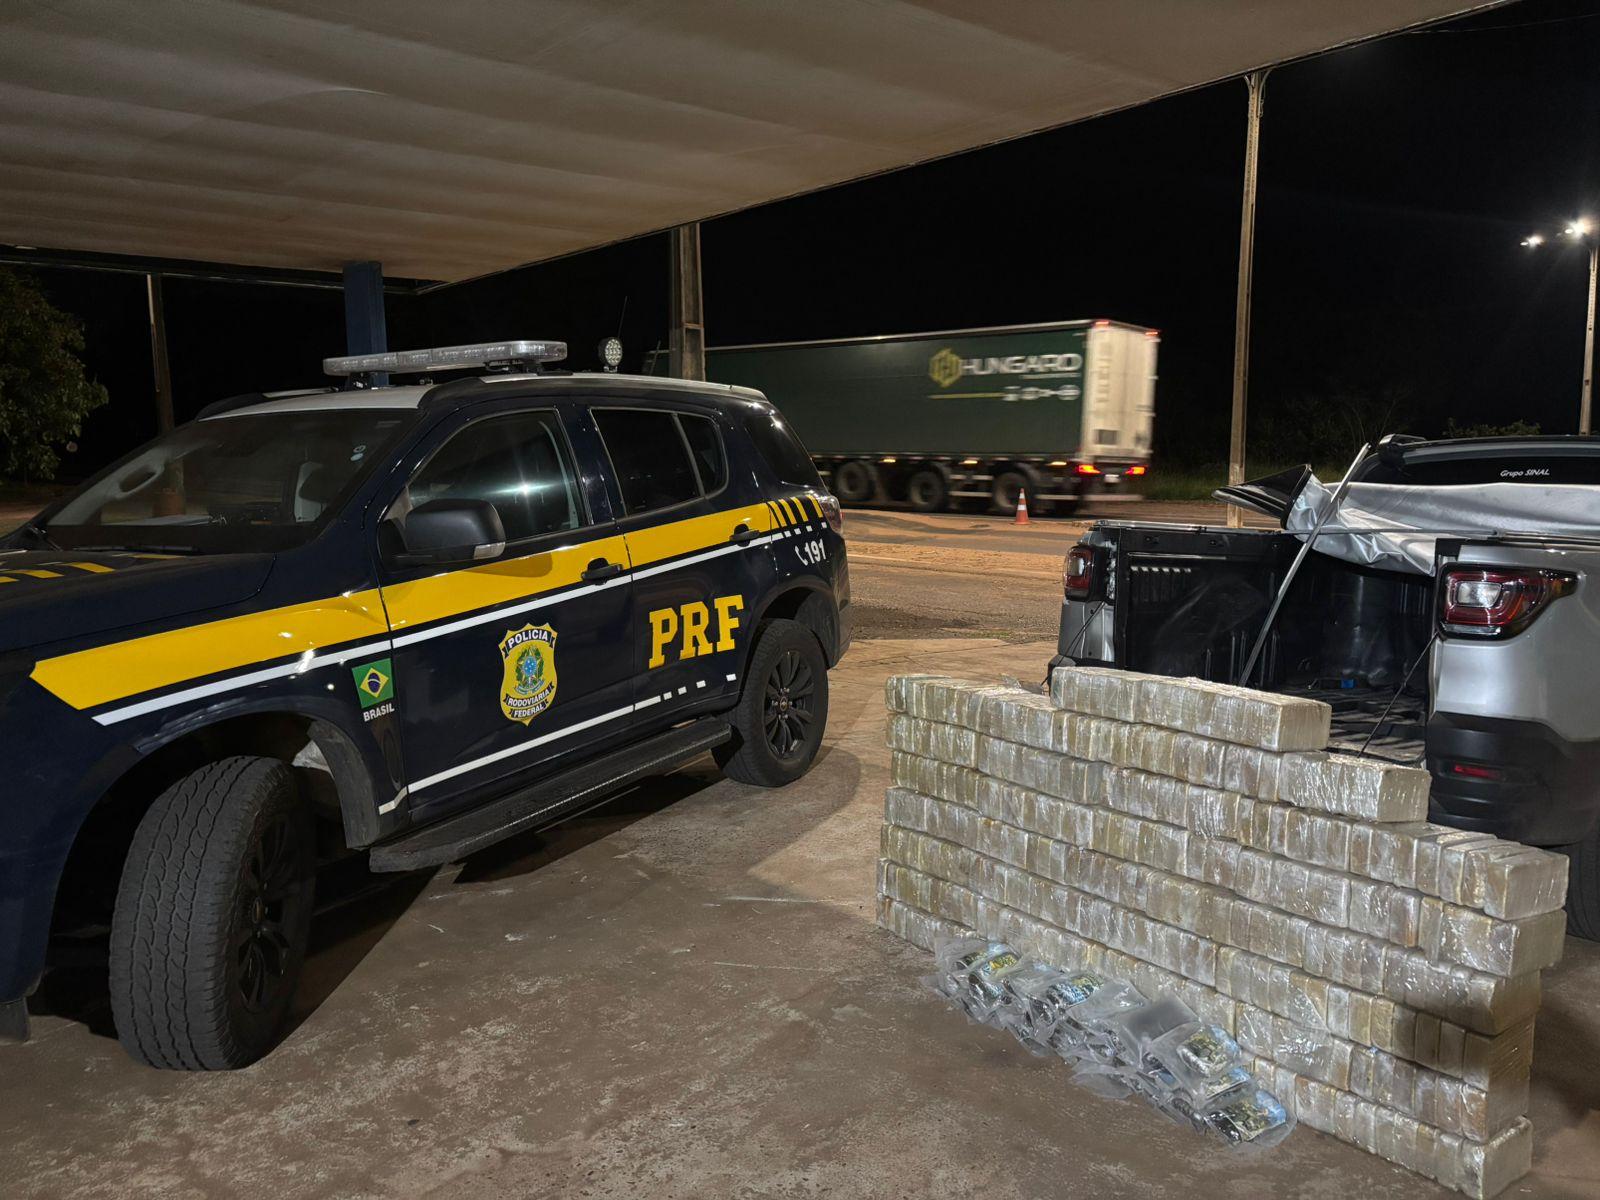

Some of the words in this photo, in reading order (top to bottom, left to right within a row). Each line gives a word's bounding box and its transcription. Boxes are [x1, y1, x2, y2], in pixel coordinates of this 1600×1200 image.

[1500, 469, 1523, 477] Grupo
[1525, 468, 1549, 476] SINAL
[804, 538, 827, 564] 191
[648, 594, 744, 669] PRF
[363, 703, 395, 722] BRASIL
[513, 702, 545, 718] FEDERAL
